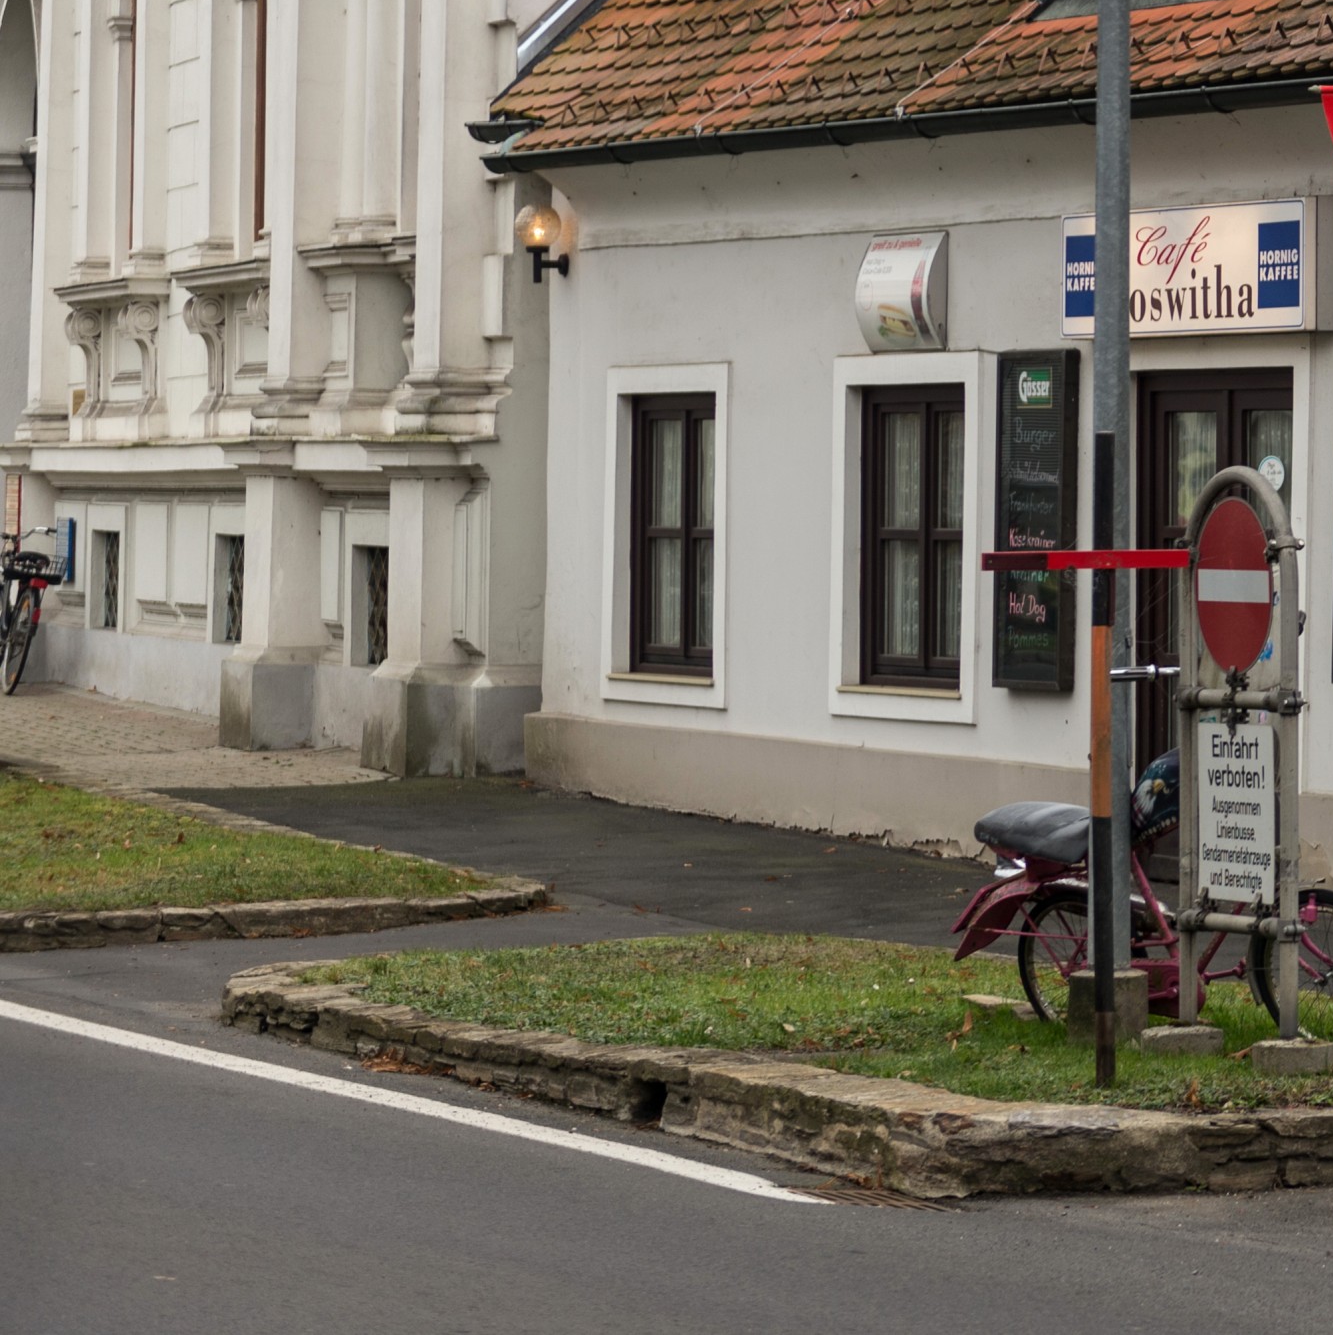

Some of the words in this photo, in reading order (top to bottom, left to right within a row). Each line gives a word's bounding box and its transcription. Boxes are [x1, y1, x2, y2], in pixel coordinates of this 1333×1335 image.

[1135, 215, 1211, 285] Café
[1259, 249, 1298, 265] HORNIG
[1066, 261, 1096, 275] HORNI
[1259, 265, 1298, 282] KAFFEE
[1066, 277, 1096, 292] KAFFE
[1129, 264, 1255, 323] oswitha
[1018, 370, 1050, 403] Gösser
[1013, 416, 1057, 452] Burger
[1009, 591, 1025, 615] Hot
[1026, 594, 1046, 623] Dog
[1211, 734, 1259, 760] Einfahrt
[1207, 764, 1266, 790] verboten!
[1211, 795, 1262, 819] Ausgenommen
[1216, 820, 1256, 843] Linienbusse,
[1202, 843, 1271, 871] Gendarmeriefahrzeuge
[1210, 868, 1222, 886] und
[1224, 869, 1263, 894] Berechtigte
